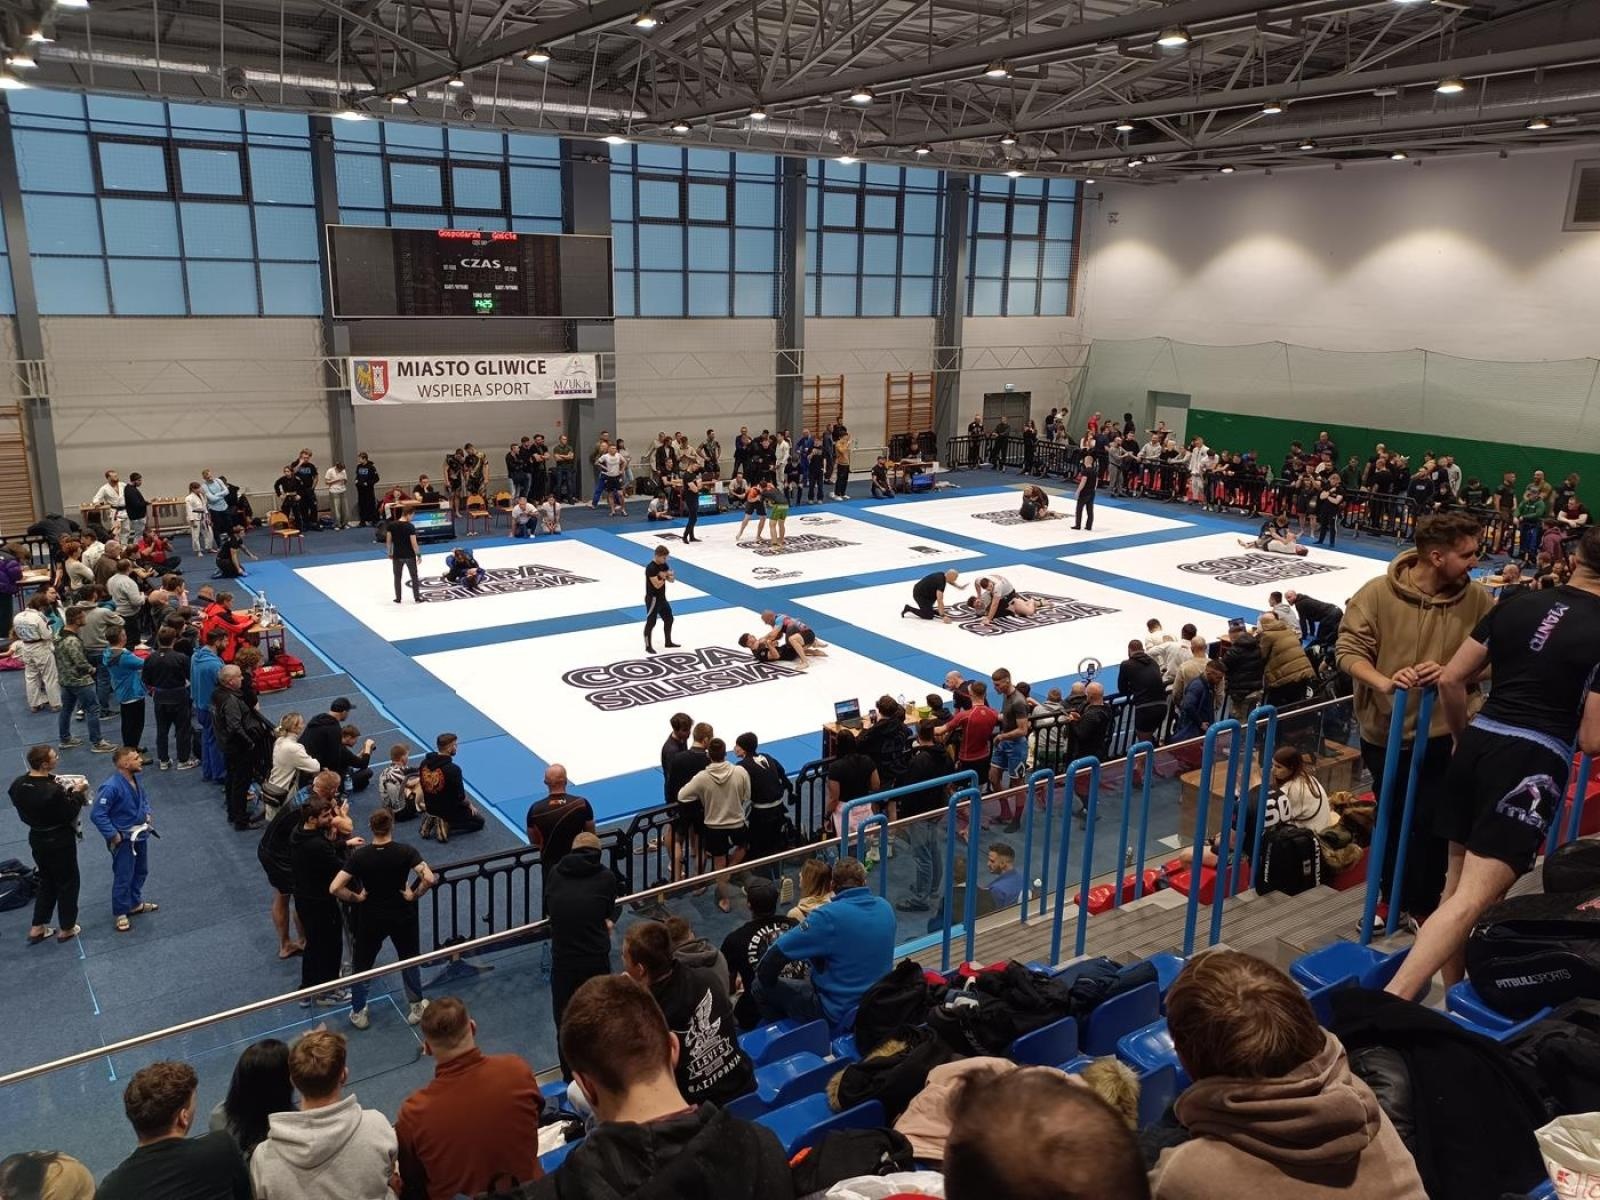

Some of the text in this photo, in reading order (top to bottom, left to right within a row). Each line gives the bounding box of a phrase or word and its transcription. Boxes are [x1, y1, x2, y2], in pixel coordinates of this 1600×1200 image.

[460, 258, 501, 269] CZAS
[397, 360, 547, 376] MIASTO GLIWICE
[417, 383, 531, 398] WSPIERA SPORT
[1529, 602, 1571, 651] MANTO
[561, 646, 756, 688] COPA
[585, 662, 808, 711] SILESIA
